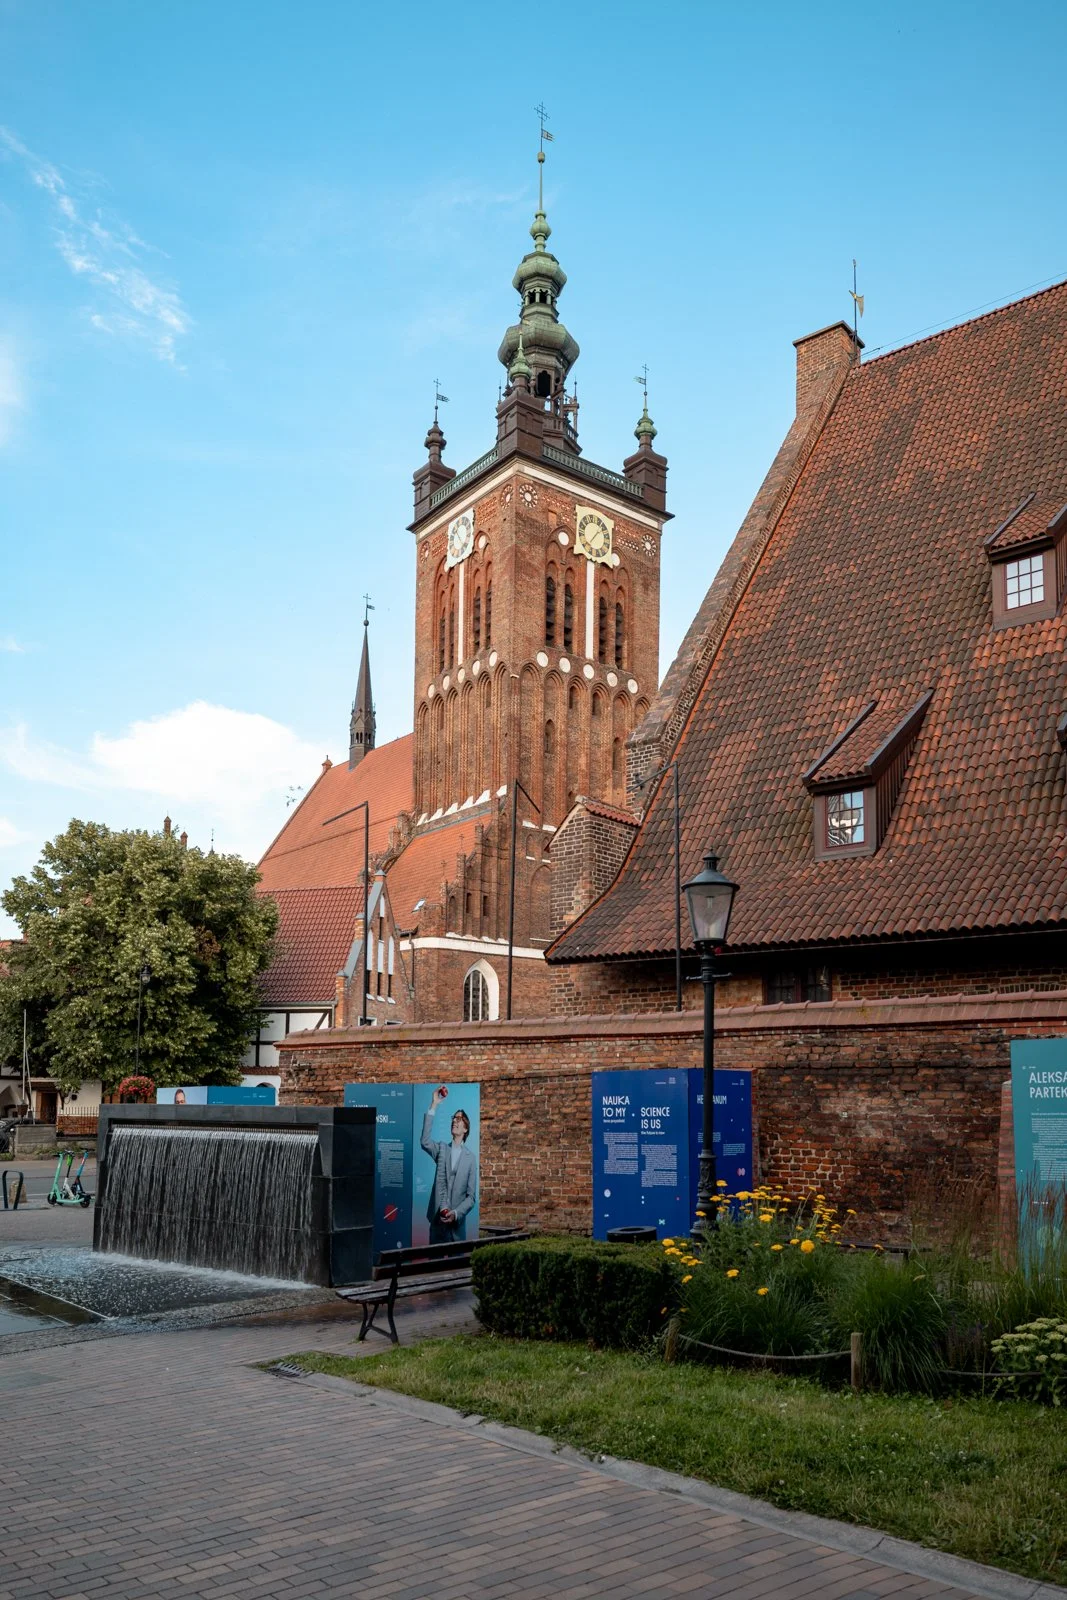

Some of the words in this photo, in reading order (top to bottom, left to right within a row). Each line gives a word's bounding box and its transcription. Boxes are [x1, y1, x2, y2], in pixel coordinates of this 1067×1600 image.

[602, 1096, 630, 1105] NAUKA
[602, 1107, 614, 1117] TO
[615, 1107, 626, 1117] MY
[640, 1106, 670, 1117] SCIENCE
[641, 1119, 649, 1129] IS
[650, 1119, 661, 1129] US
